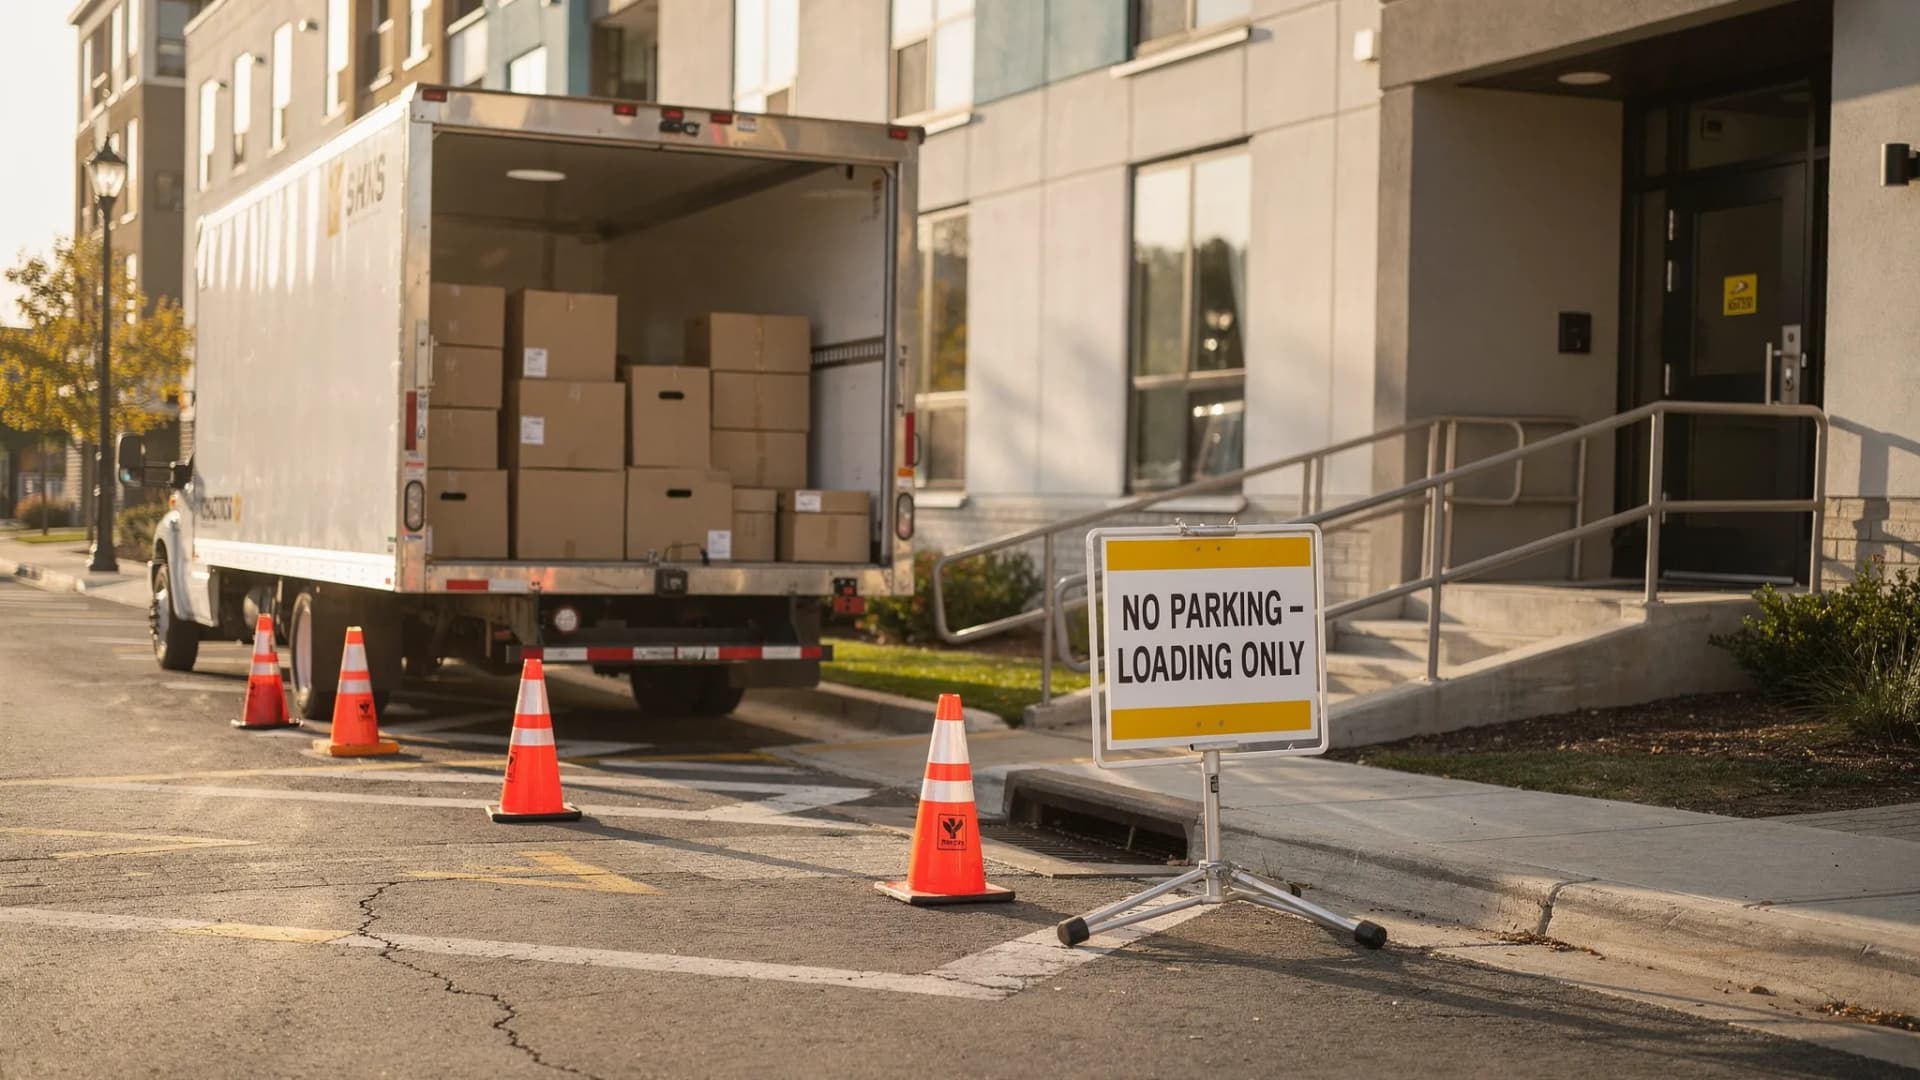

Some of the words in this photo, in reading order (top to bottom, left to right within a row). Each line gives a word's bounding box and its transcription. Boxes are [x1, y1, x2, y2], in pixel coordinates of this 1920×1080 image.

[1122, 593, 1160, 631] NO
[1170, 589, 1282, 630] PARKING
[1117, 642, 1232, 684] LOADING
[1241, 640, 1305, 679] ONLY
